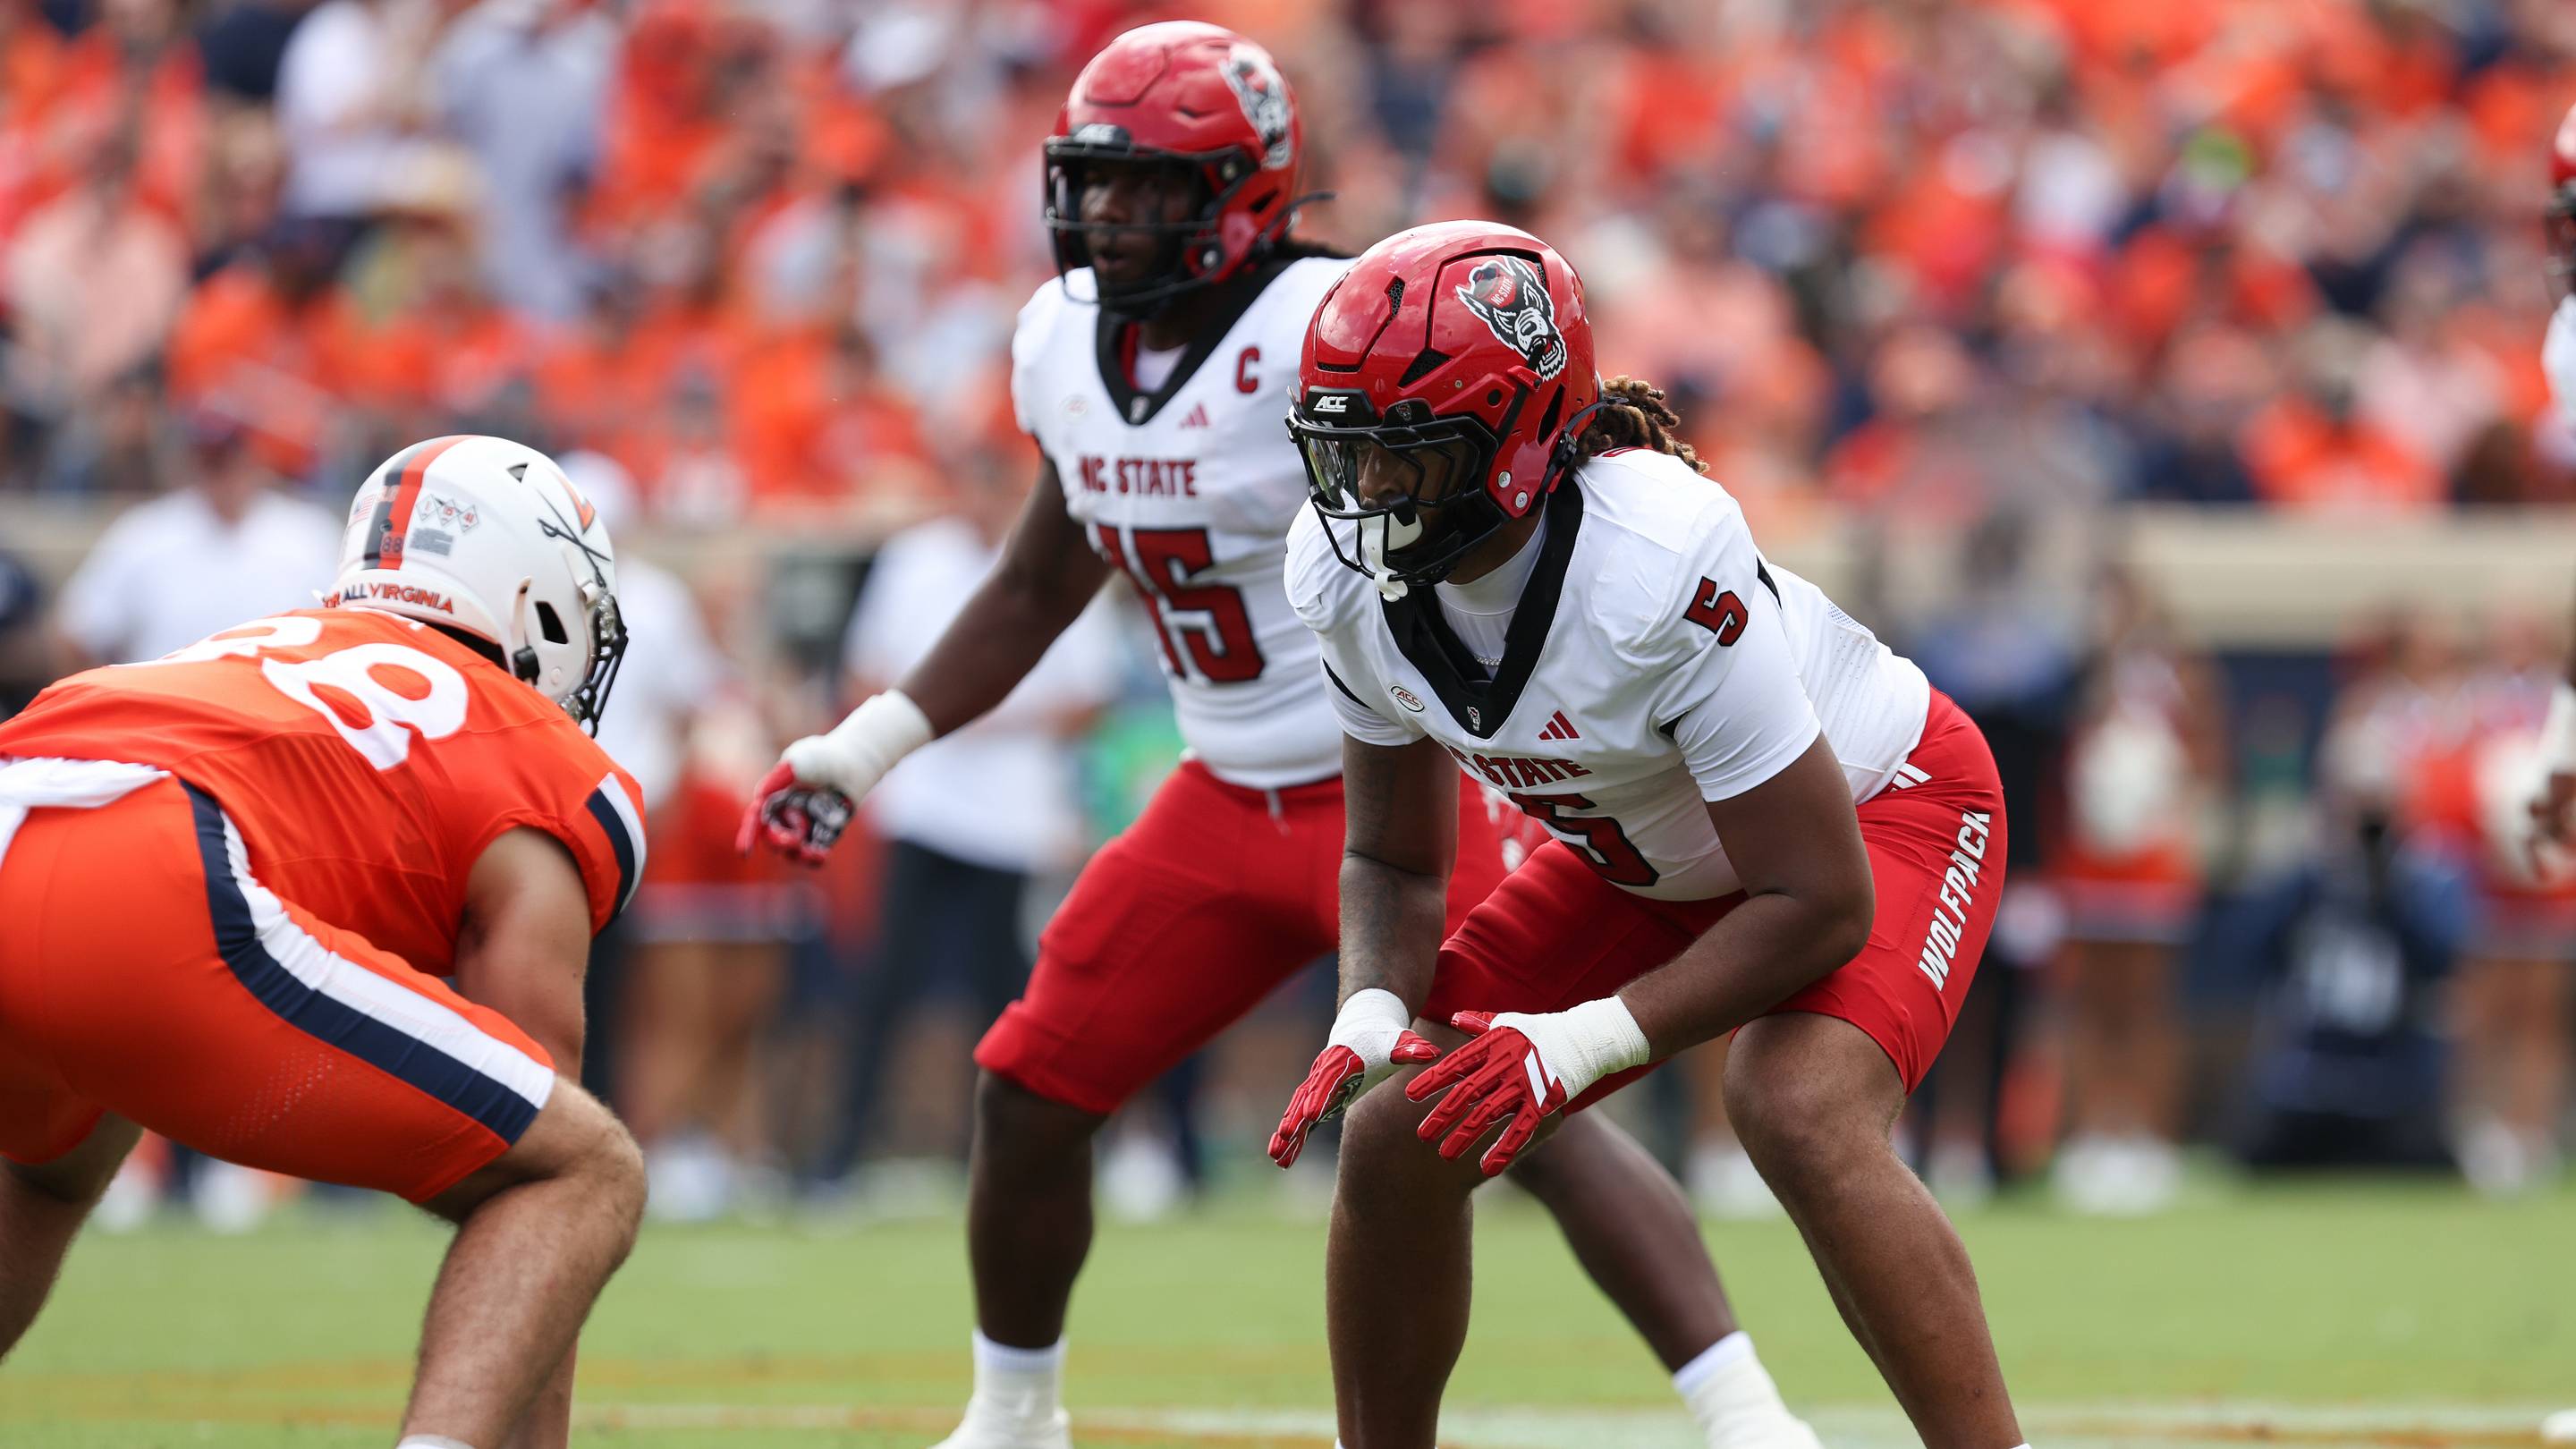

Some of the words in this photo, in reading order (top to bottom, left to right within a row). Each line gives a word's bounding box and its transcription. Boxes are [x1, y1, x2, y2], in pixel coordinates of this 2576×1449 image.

[1490, 294, 1504, 305] NC
[1498, 276, 1513, 299] STATE
[1234, 345, 1262, 394] C
[1315, 395, 1349, 410] ACC
[1079, 455, 1106, 492] NC
[1116, 458, 1197, 496] STATE
[382, 536, 402, 553] 88
[1095, 521, 1266, 683] 15
[1682, 575, 1749, 647] 5
[1396, 691, 1419, 706] ACC
[1472, 753, 1593, 788] STATE
[1918, 811, 1990, 992] WOLFPACK
